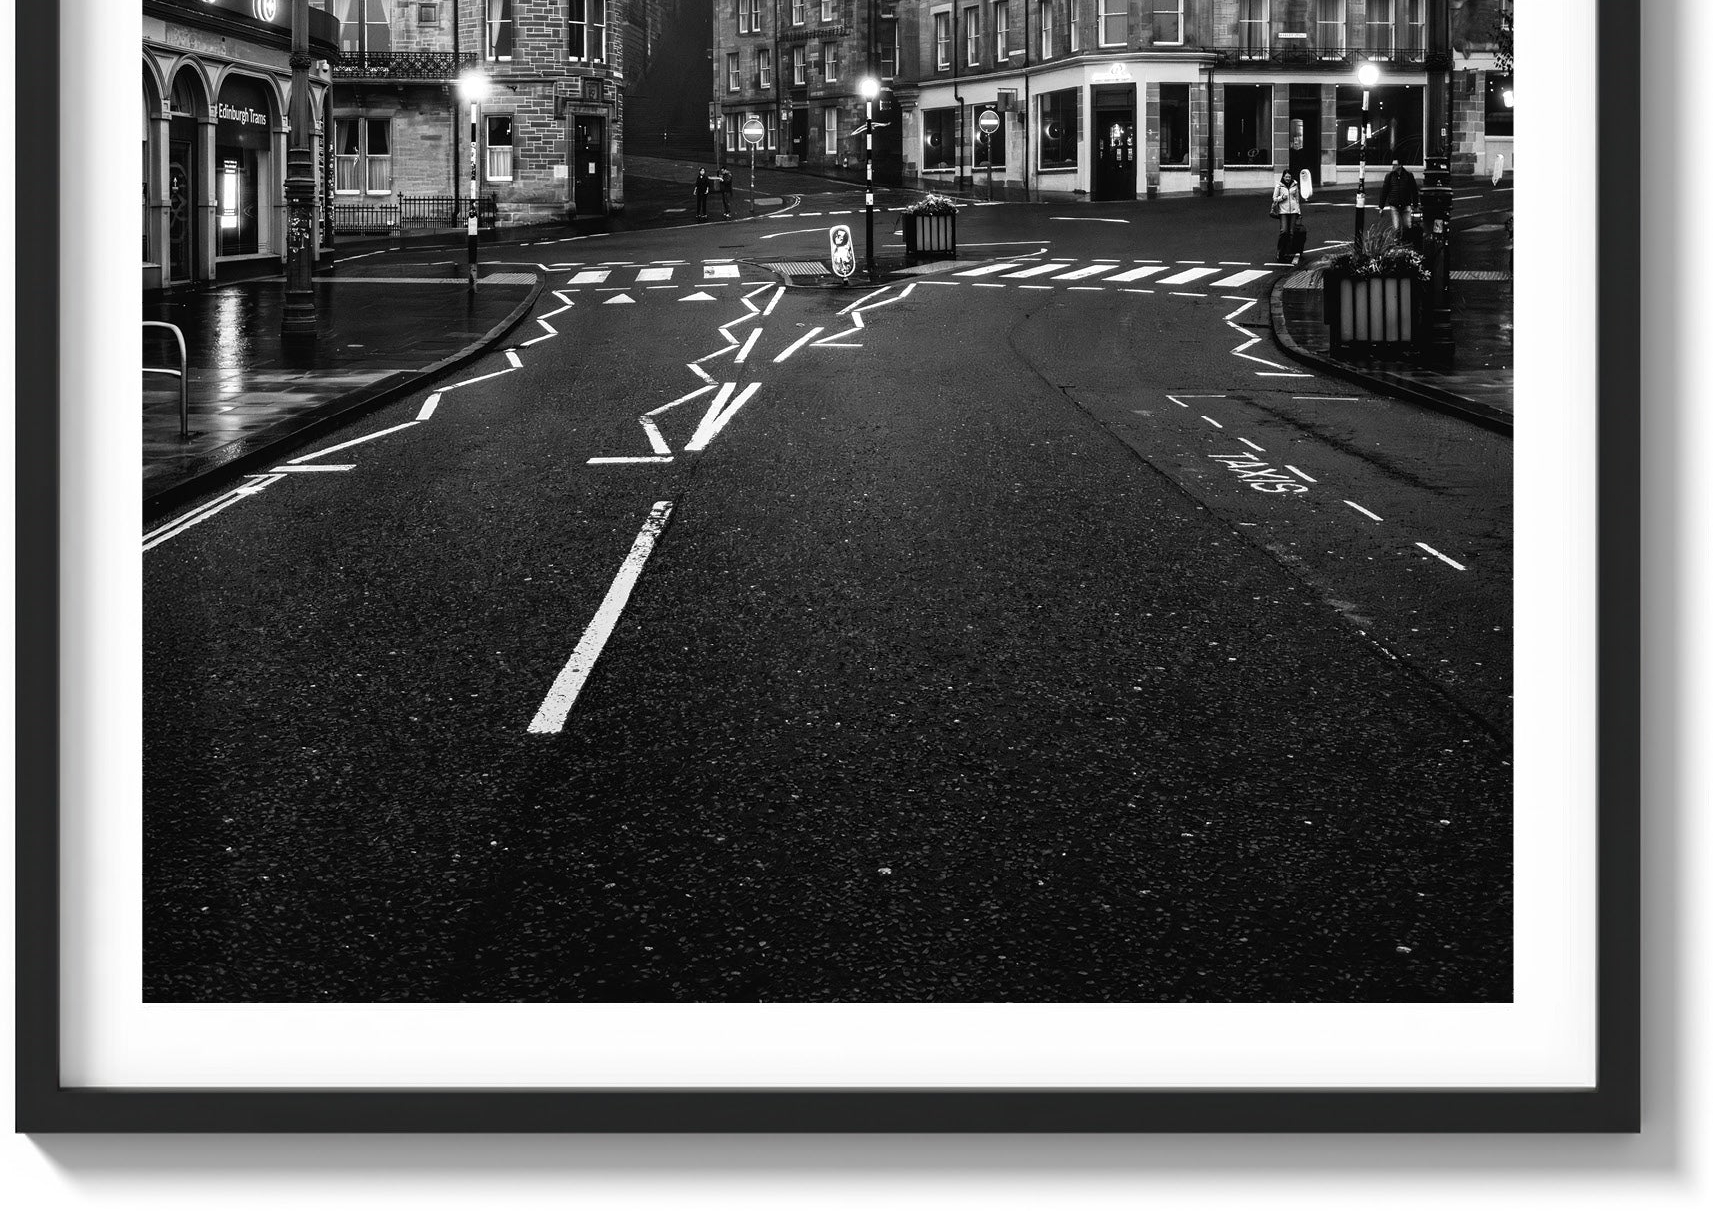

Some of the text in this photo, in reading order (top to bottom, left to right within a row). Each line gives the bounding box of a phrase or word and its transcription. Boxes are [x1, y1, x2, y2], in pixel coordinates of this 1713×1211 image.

[218, 103, 267, 125] Edinburgh Trams
[1207, 451, 1309, 493] TAXIS
